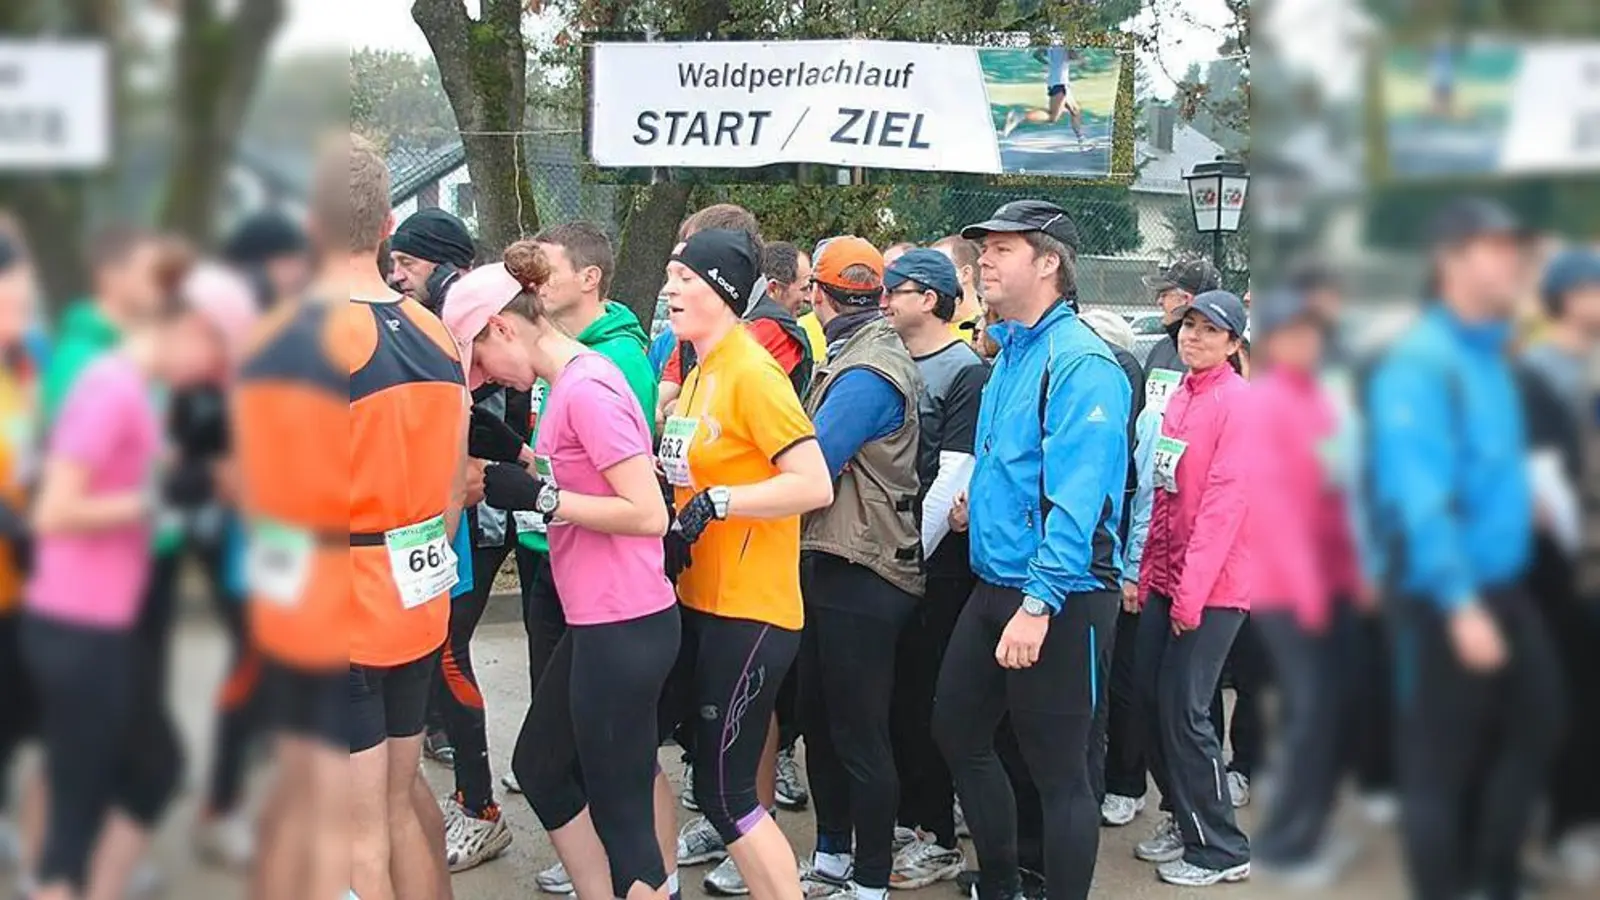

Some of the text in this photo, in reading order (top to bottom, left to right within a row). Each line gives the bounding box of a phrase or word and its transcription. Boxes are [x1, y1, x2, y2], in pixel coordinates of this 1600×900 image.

[678, 59, 915, 93] Waldperlachlauf
[633, 110, 772, 146] START
[830, 107, 931, 149] ZIEL
[661, 436, 683, 459] 66.2
